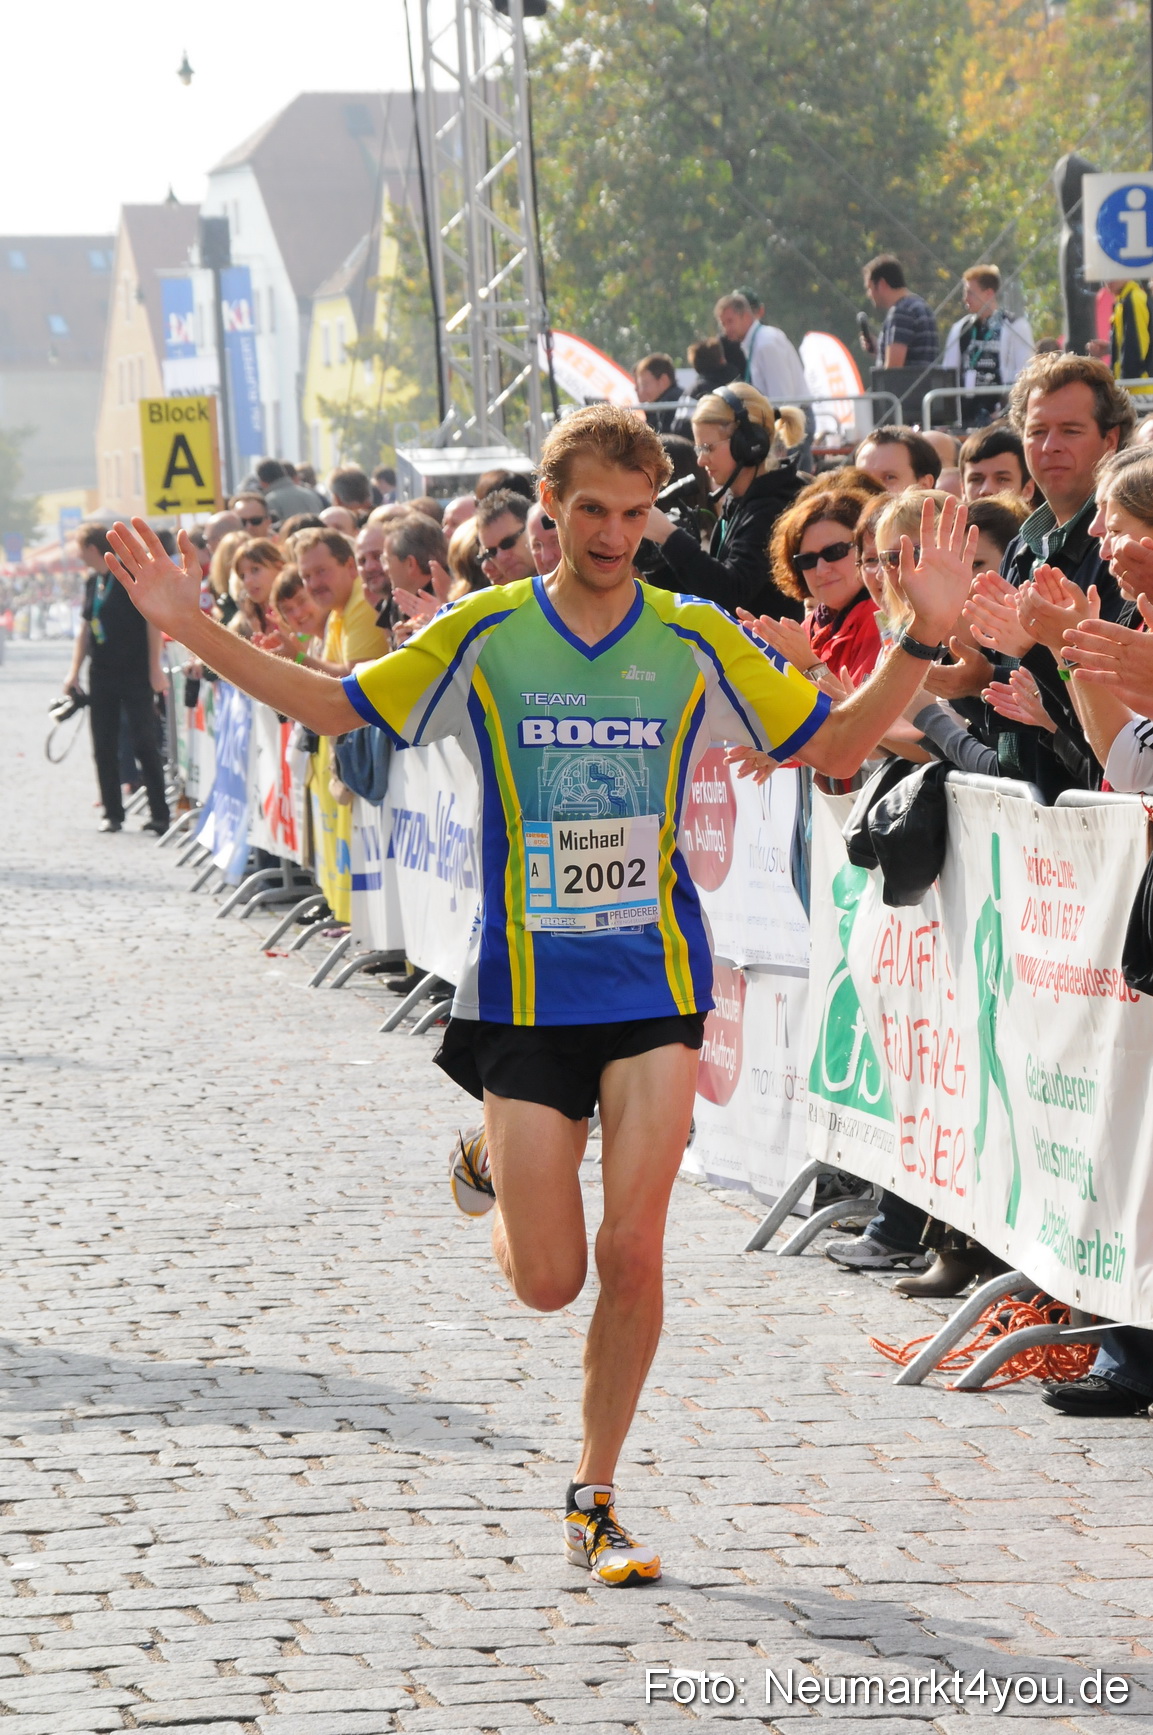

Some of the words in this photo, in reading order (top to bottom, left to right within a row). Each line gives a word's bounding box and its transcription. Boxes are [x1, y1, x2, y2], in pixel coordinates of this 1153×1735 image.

[148, 402, 209, 424] Block
[162, 432, 205, 489] A
[521, 692, 587, 706] TEAM
[518, 717, 666, 748] BOCK
[559, 827, 624, 851] Michael
[531, 862, 539, 877] A
[563, 858, 646, 894] 2002
[609, 906, 659, 920] PFLEIDERER
